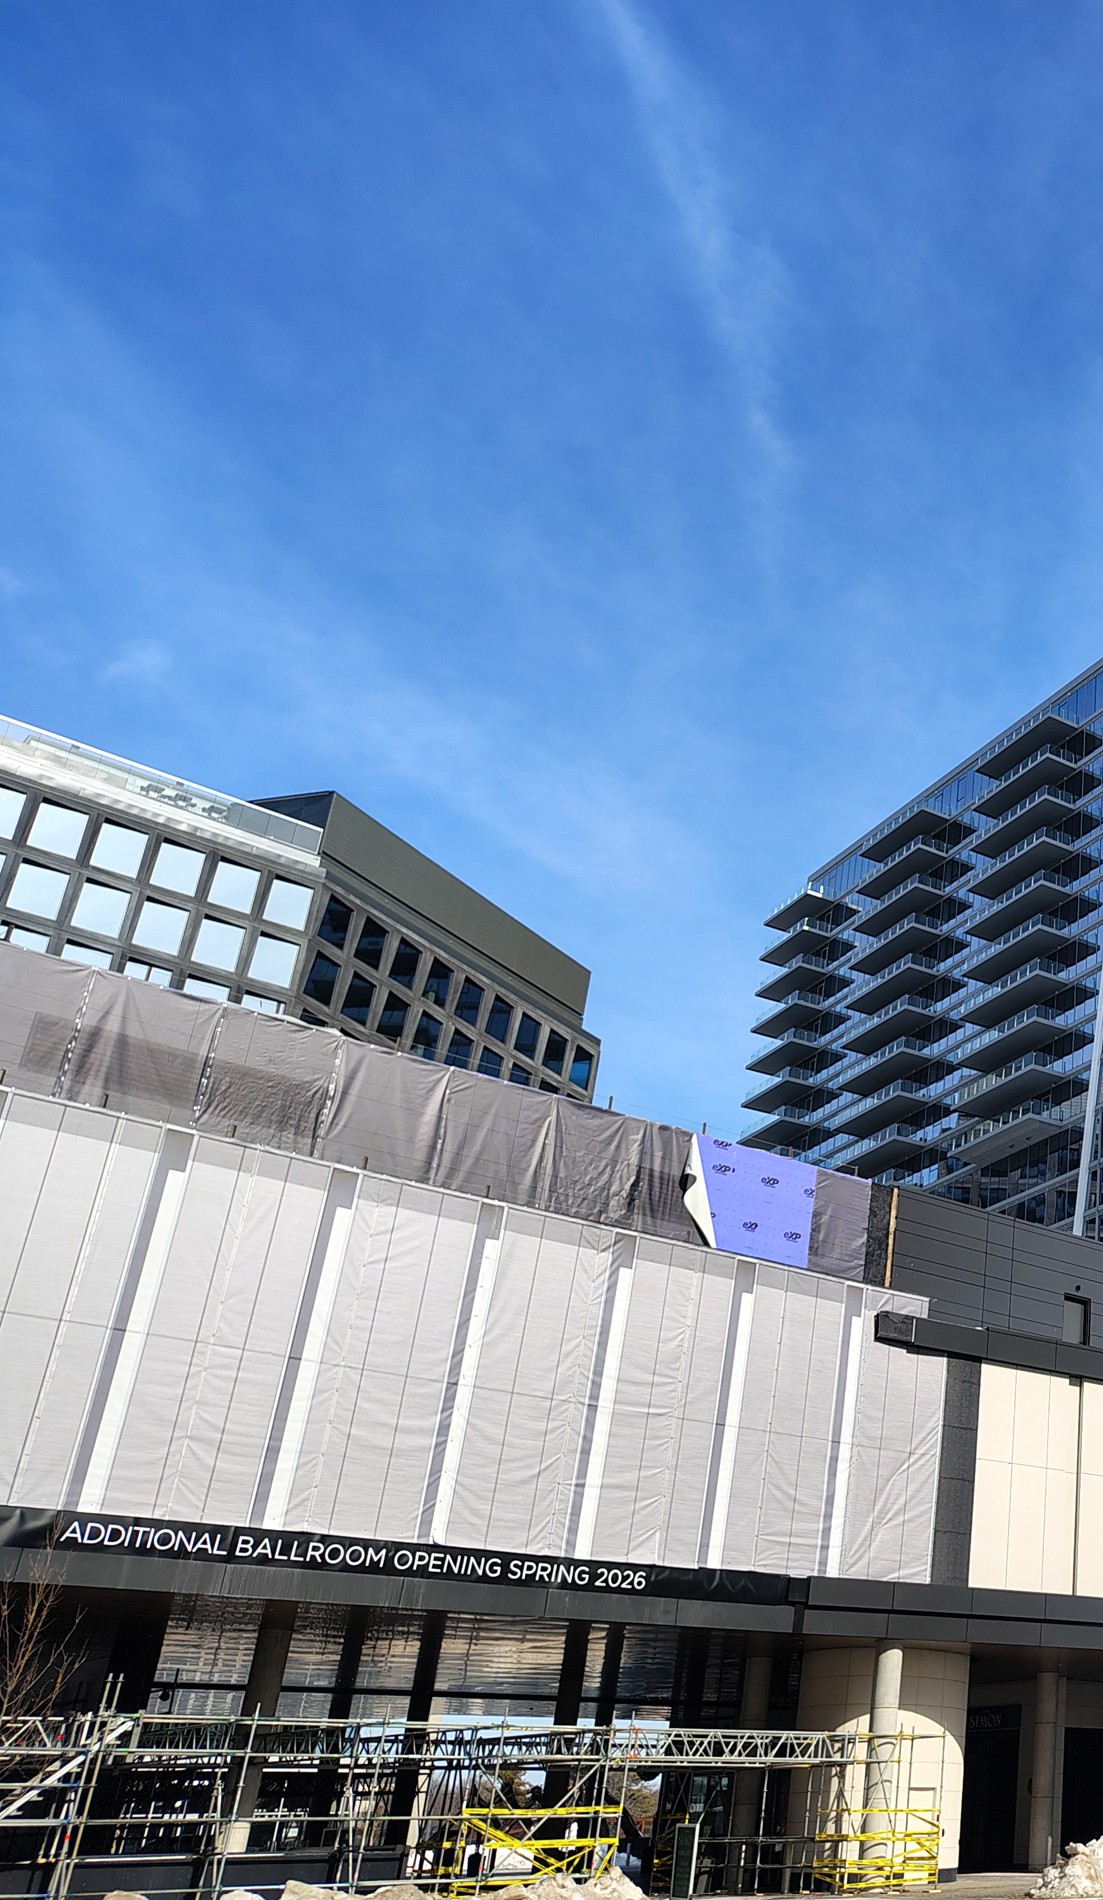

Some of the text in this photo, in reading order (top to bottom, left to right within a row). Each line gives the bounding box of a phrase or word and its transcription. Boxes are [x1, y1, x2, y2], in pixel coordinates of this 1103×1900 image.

[59, 1521, 647, 1590] ADDITIONAL BALLROOM OPENING SPRING 2026
[969, 1713, 1002, 1728] SIMON
